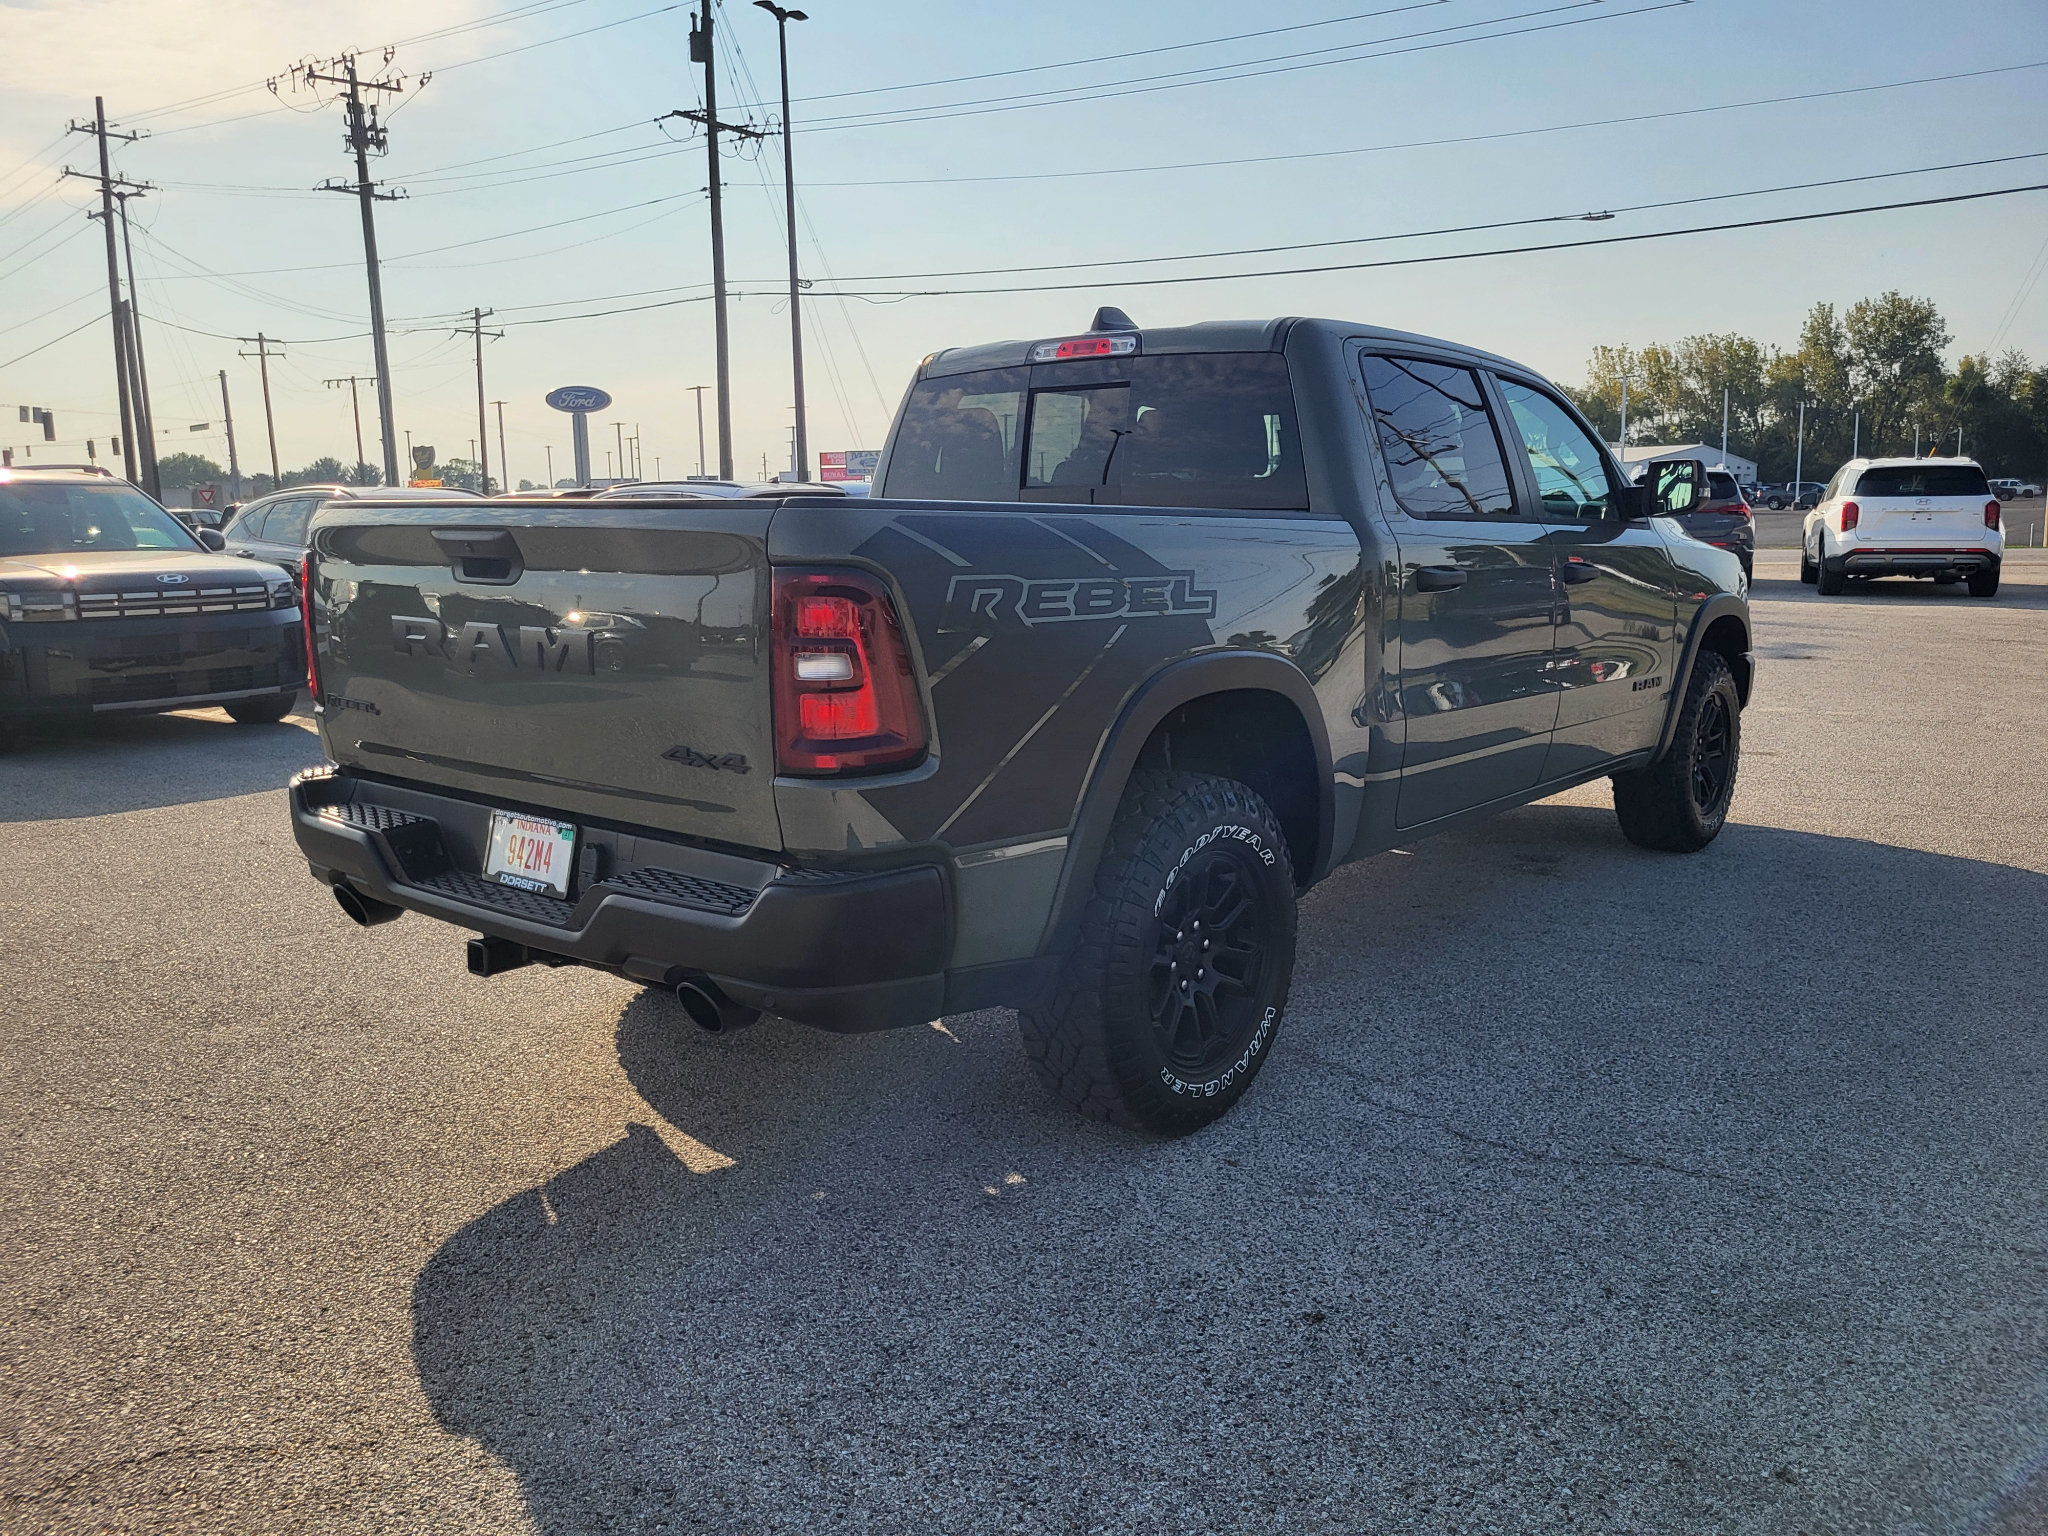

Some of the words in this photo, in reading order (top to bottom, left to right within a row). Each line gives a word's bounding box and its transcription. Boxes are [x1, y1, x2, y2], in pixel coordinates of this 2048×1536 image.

[558, 391, 596, 407] Ford
[946, 574, 1213, 629] REBEL
[391, 615, 596, 676] RAM
[1632, 676, 1662, 691] RAM
[495, 808, 573, 829] dorsettautomotive.com
[516, 820, 551, 836] INDIANA
[1154, 824, 1275, 918] GOODYEAR
[500, 873, 547, 893] DORSETT
[1160, 1006, 1276, 1098] WRANGLER
